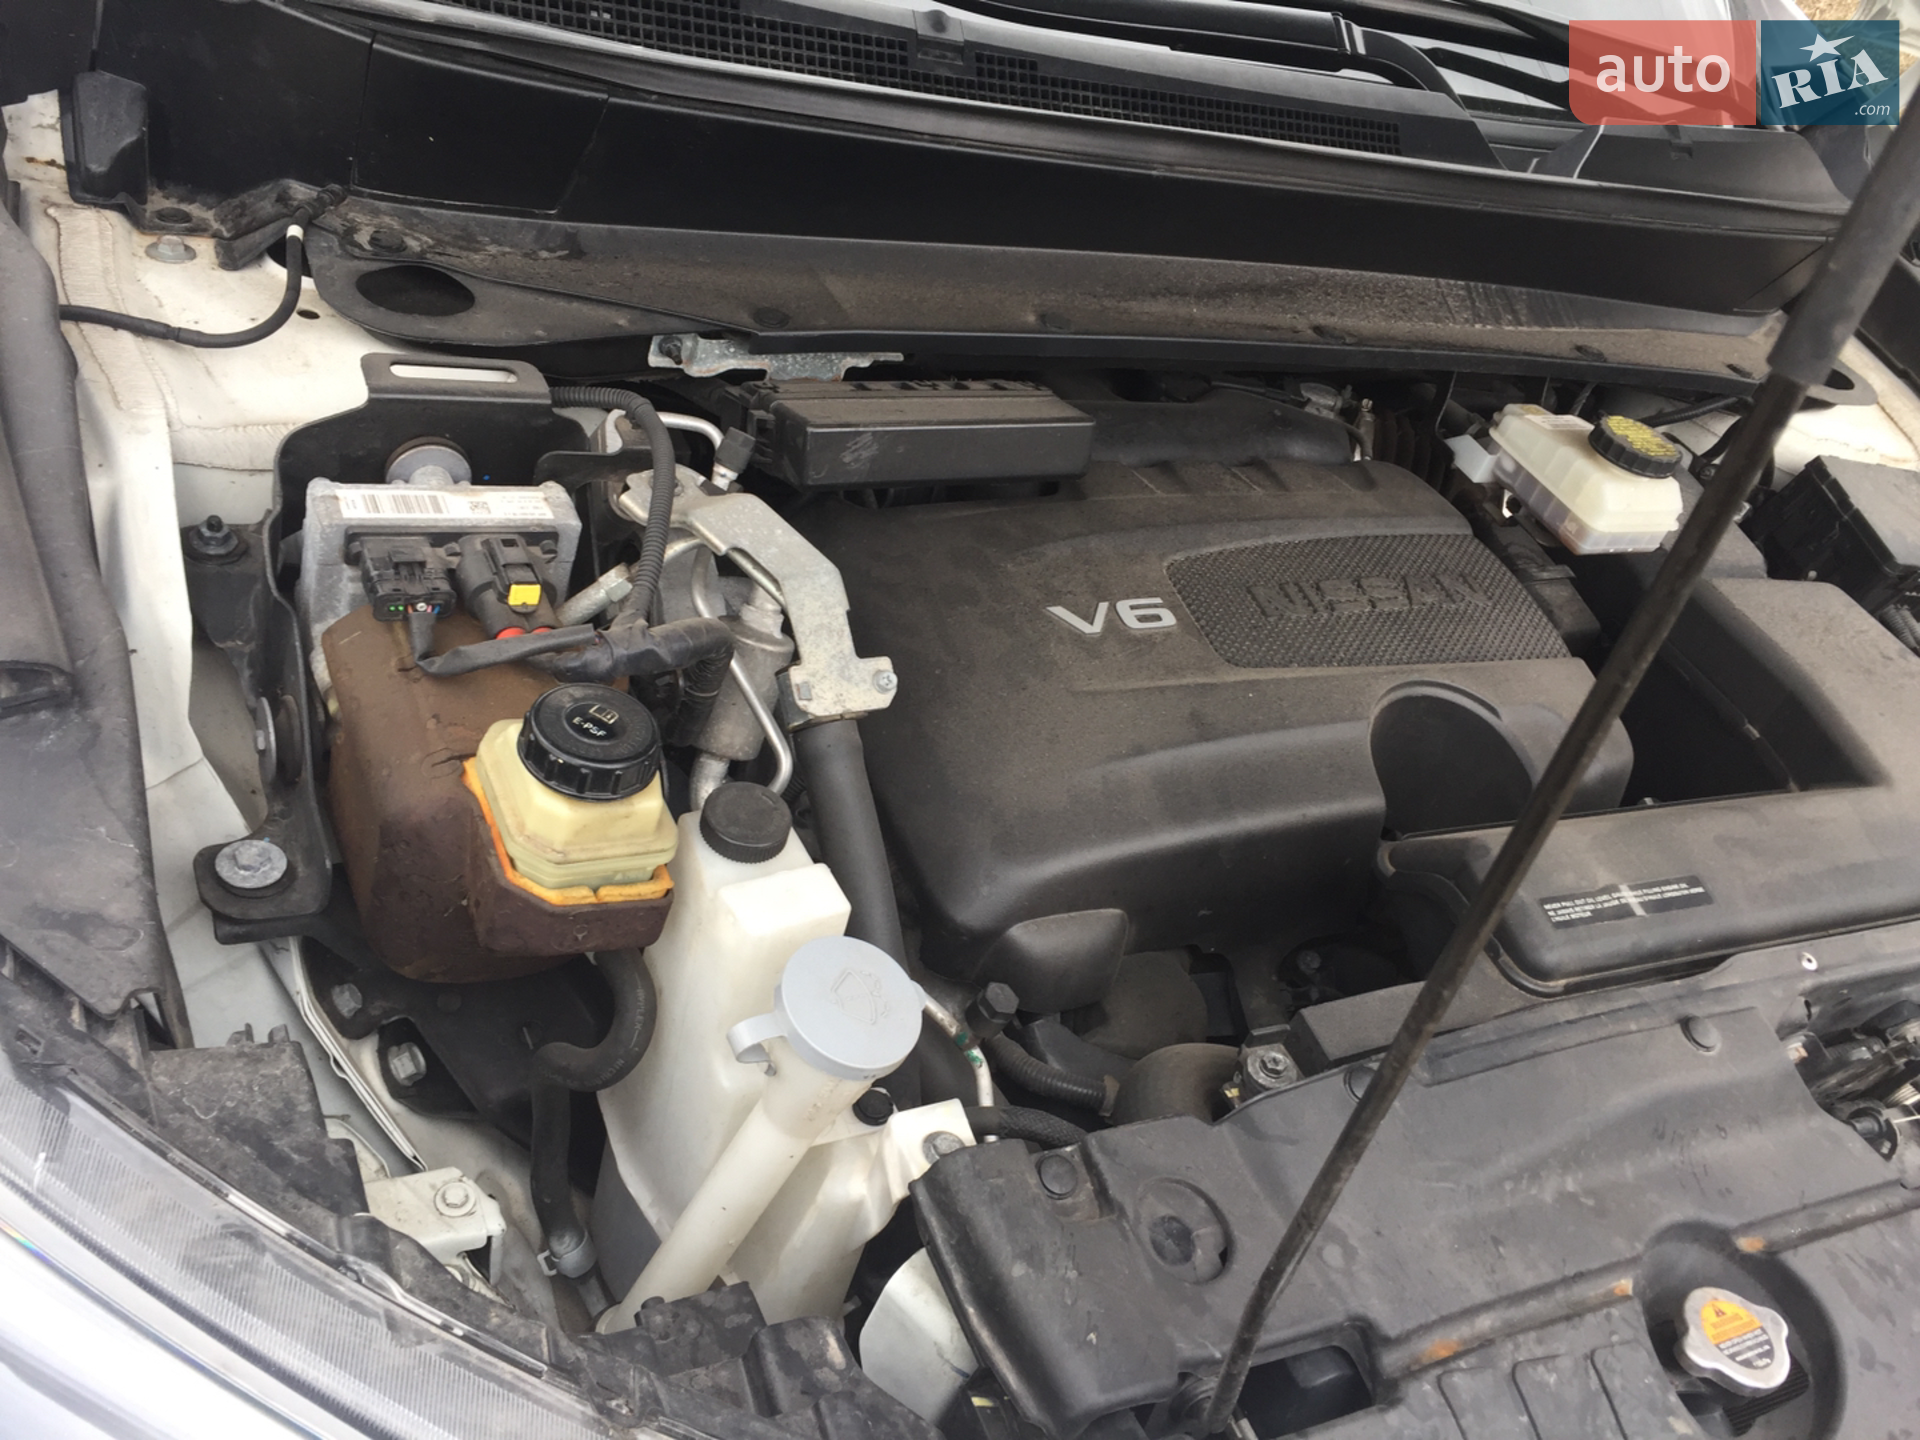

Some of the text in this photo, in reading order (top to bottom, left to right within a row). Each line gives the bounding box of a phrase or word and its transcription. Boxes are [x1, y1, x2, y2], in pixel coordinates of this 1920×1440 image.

[1247, 574, 1493, 619] NISSAN
[1046, 597, 1178, 635] V6
[572, 716, 608, 737] E-PSF
